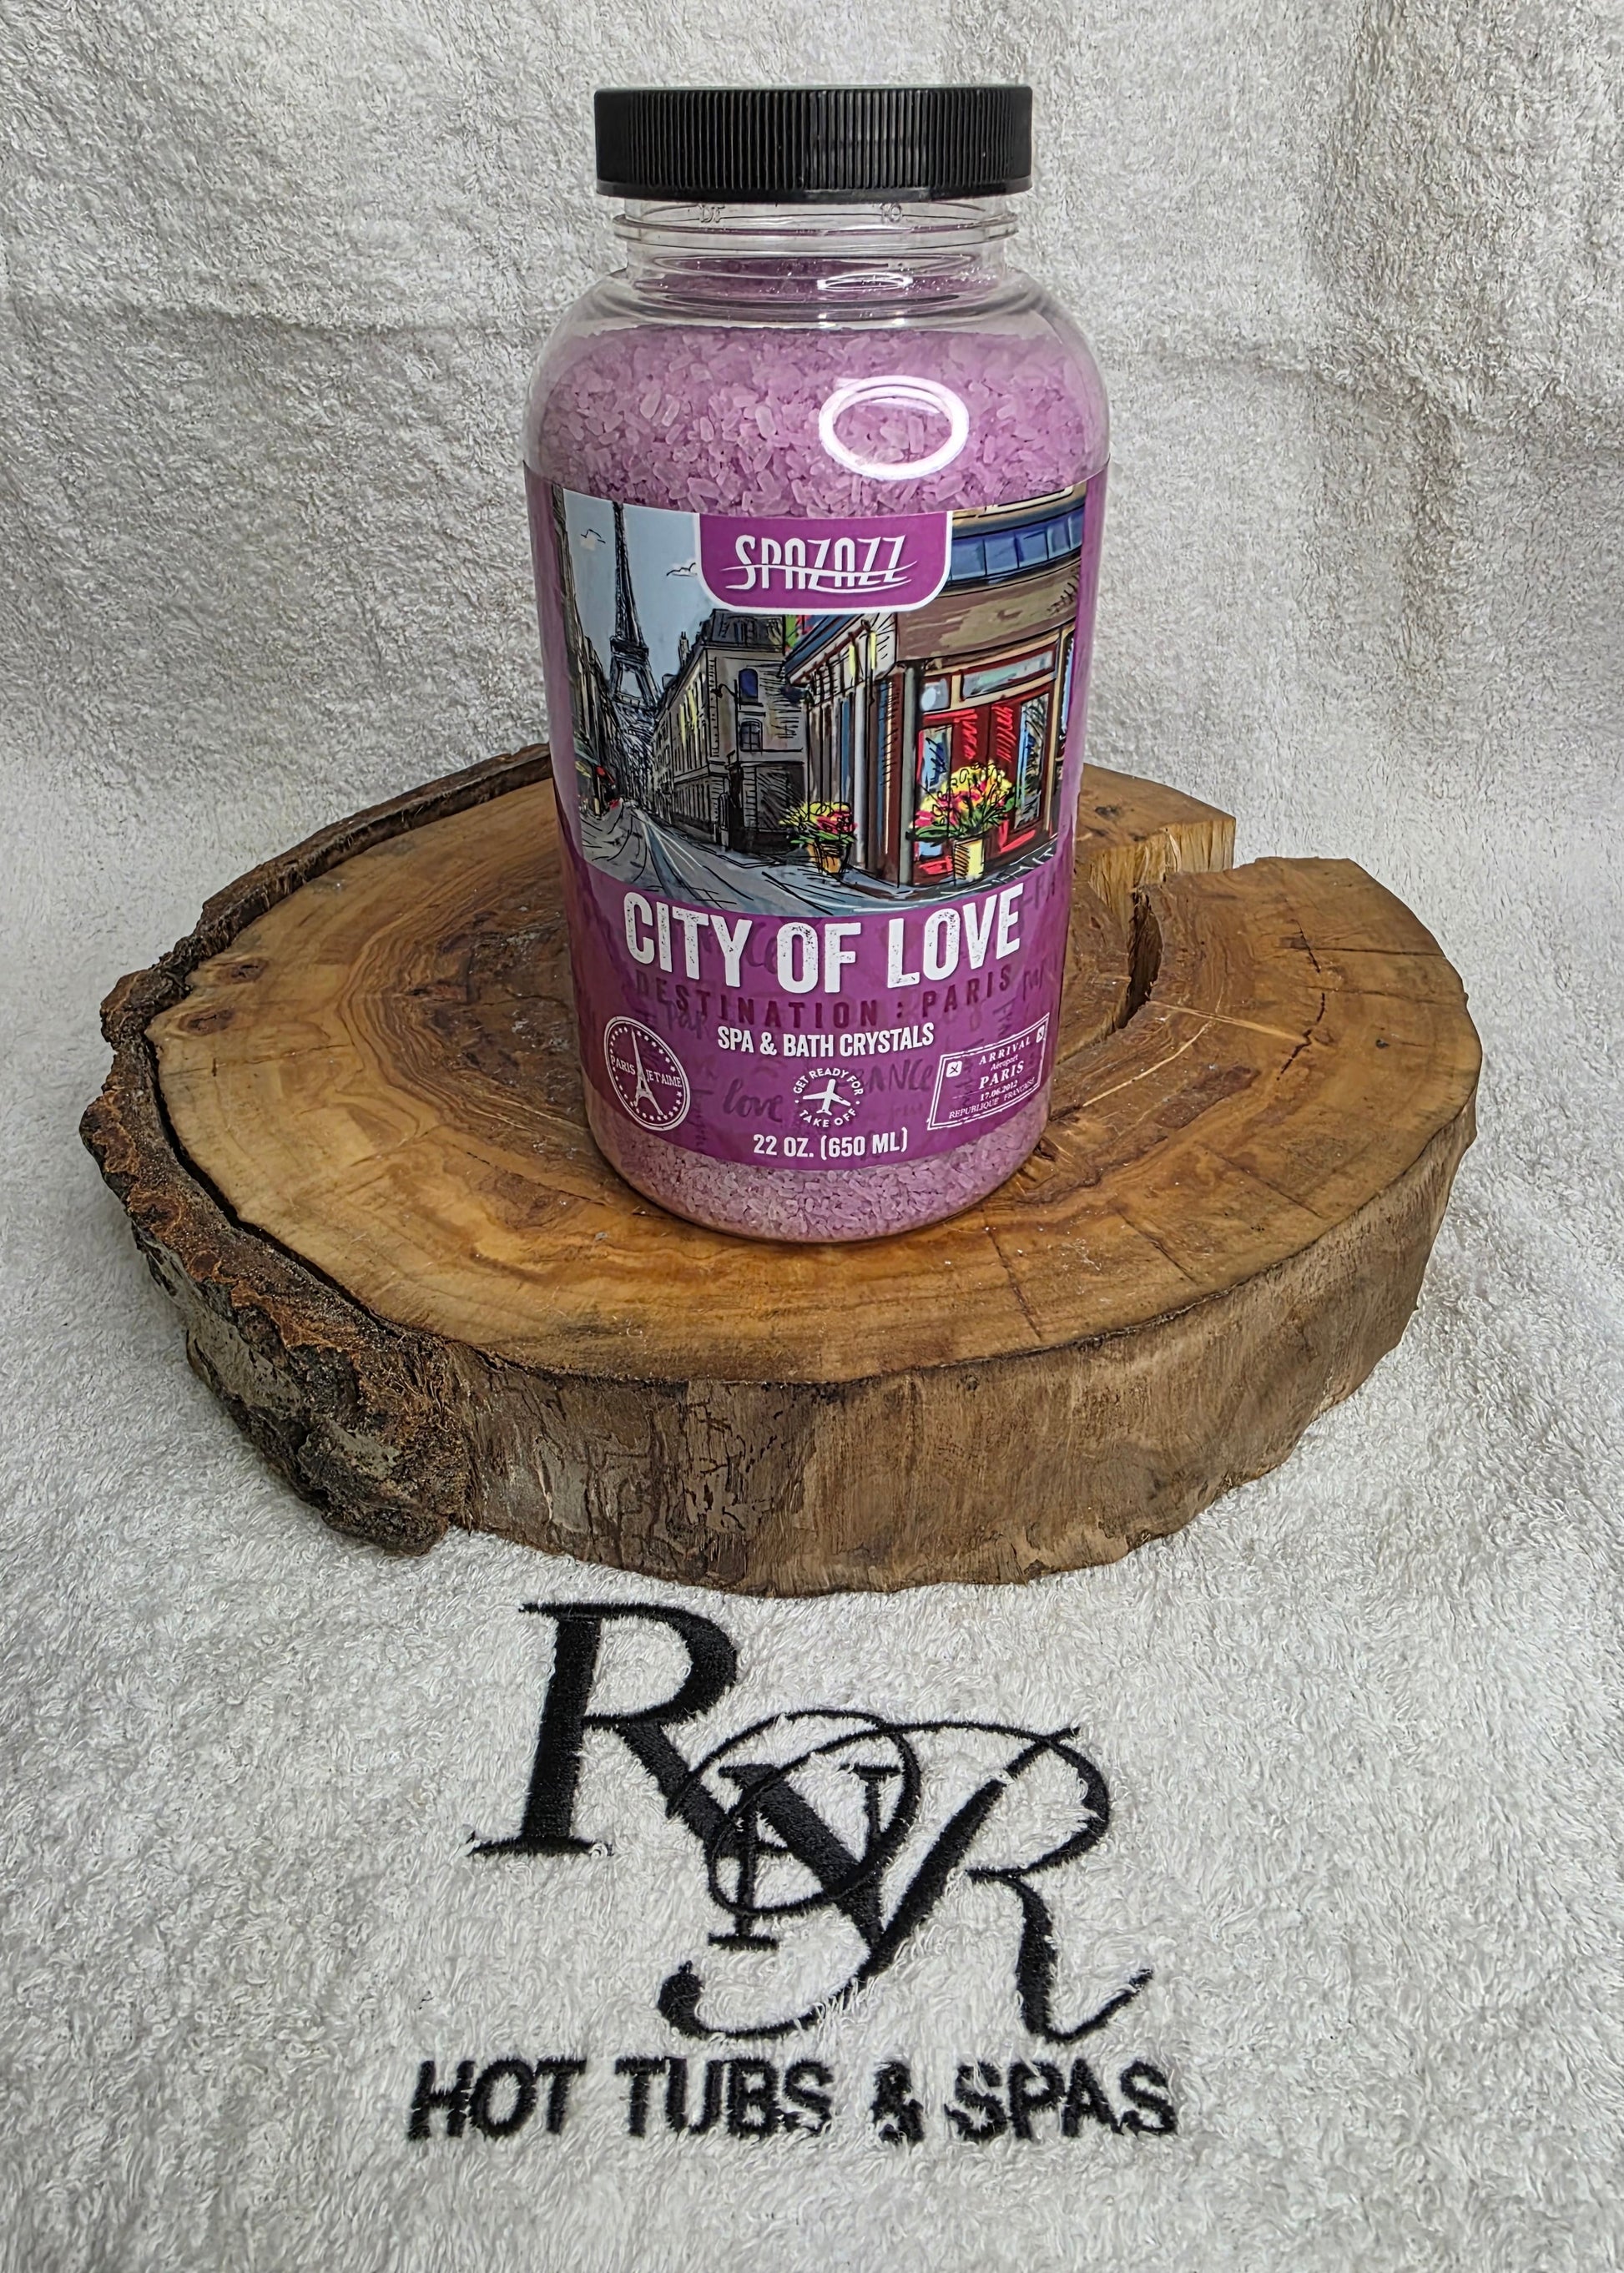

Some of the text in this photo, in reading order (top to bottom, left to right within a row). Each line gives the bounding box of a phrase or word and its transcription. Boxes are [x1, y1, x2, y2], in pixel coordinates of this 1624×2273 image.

[721, 534, 917, 593] SPAZAZZ
[623, 891, 753, 988] CITY
[777, 922, 861, 994] OF
[887, 883, 1023, 989] LOVE
[636, 970, 877, 1029] DESTINATION
[922, 964, 1011, 1017] PARIS
[718, 1022, 934, 1057] SPA & BATH CRYSTALS
[979, 1036, 1031, 1066] ARRIVAL
[610, 1055, 636, 1076] PARIS
[793, 1067, 864, 1096] GET READY FOR
[979, 1061, 1025, 1090] PARIS
[799, 1108, 856, 1127] TAKE OFF
[753, 1126, 908, 1161] 22 OZ. (650 ML)
[408, 2056, 1178, 2144] HOT TUBS & SPAS
